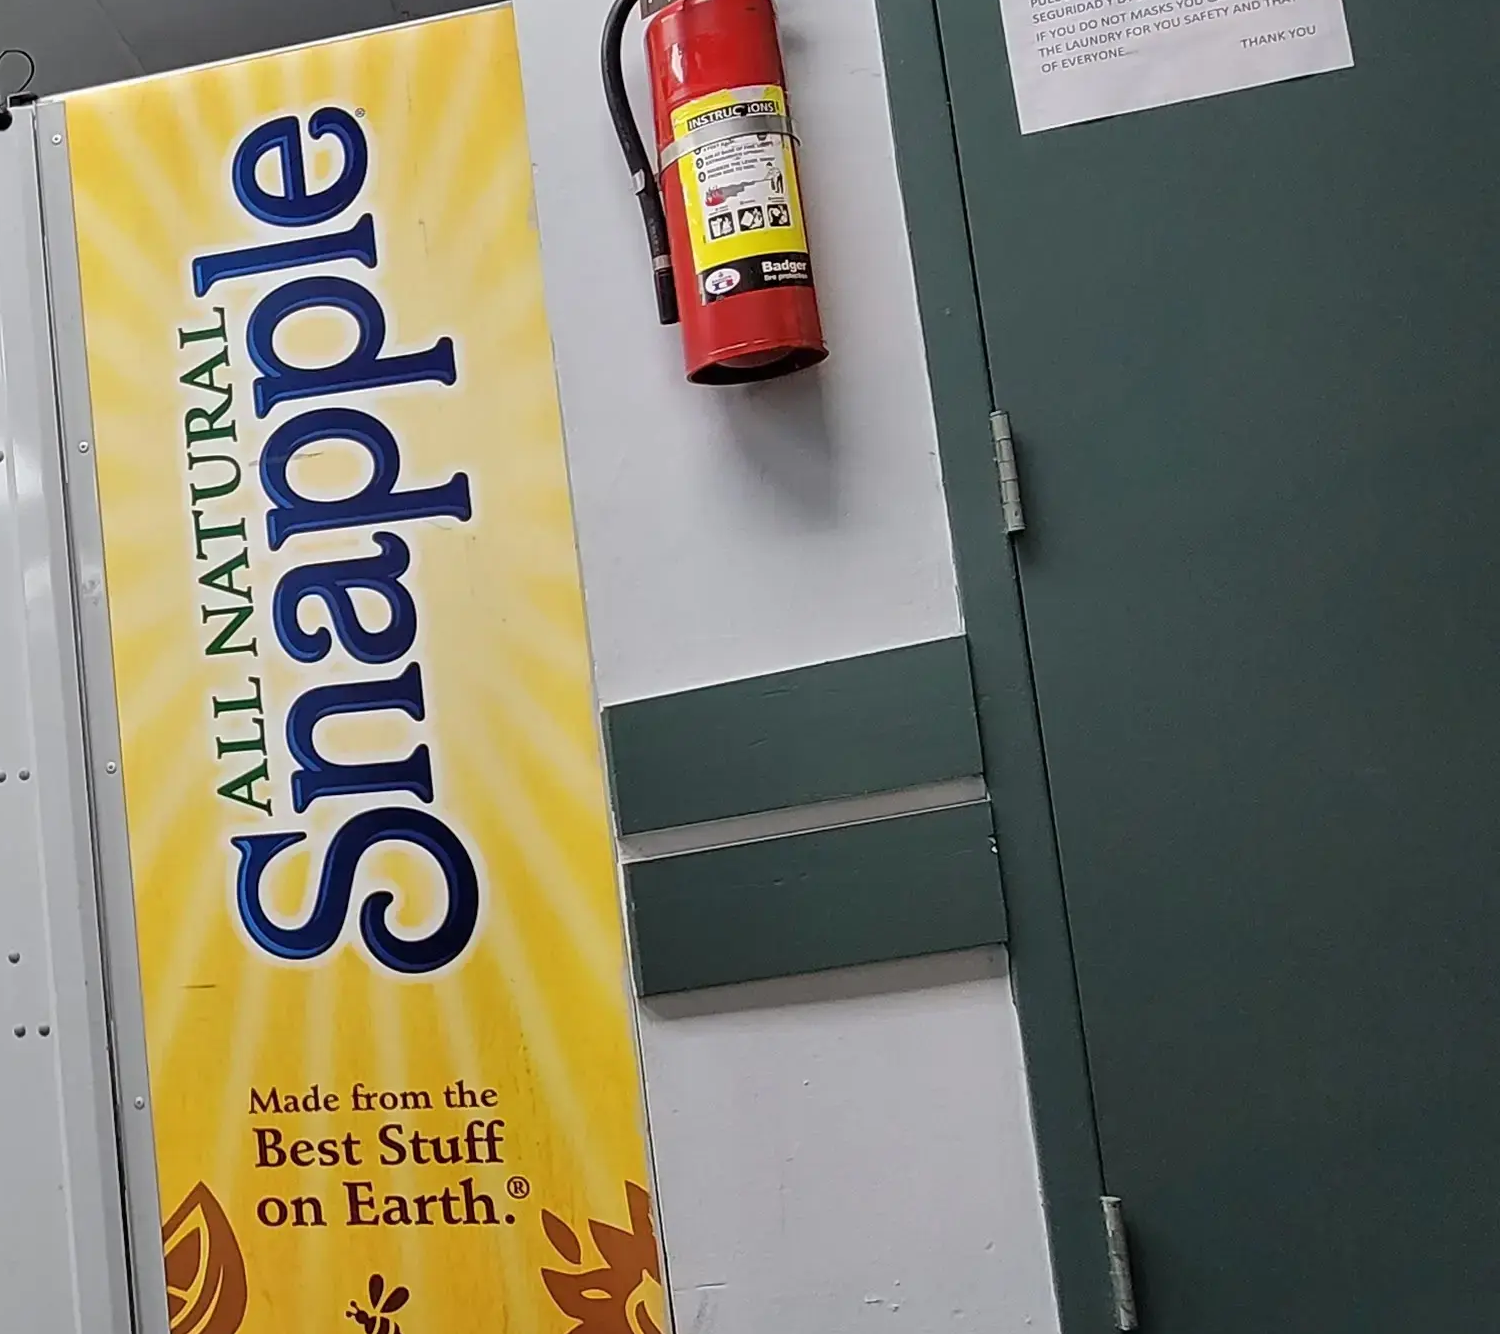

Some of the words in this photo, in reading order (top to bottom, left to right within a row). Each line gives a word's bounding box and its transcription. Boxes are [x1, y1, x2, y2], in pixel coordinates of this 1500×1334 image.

[1032, 0, 1103, 24] SEGURIDAD
[1036, 31, 1047, 42] IF
[1049, 24, 1076, 39] YOU
[1079, 19, 1098, 32] DO
[1101, 13, 1127, 26] NOT
[1130, 2, 1174, 21] MASKS
[1038, 43, 1063, 58] THE
[1065, 30, 1122, 52] LAUNDRY
[1125, 24, 1151, 38] FOR
[1153, 16, 1181, 31] YOU
[1183, 6, 1229, 26] SAFETY
[1232, 0, 1261, 15] AND
[1240, 30, 1286, 49] THANK
[1288, 25, 1317, 39] YOU
[1041, 61, 1058, 74] OF
[688, 101, 775, 130] INSTRUCIONS
[177, 306, 260, 658] NATURAL
[192, 106, 480, 974] Snapple
[216, 677, 273, 812] ALL
[249, 1083, 340, 1115] Made
[351, 1082, 432, 1113] from
[443, 1080, 498, 1108] the
[252, 1127, 362, 1168] Best
[378, 1120, 506, 1166] Stuff
[256, 1196, 327, 1228] on
